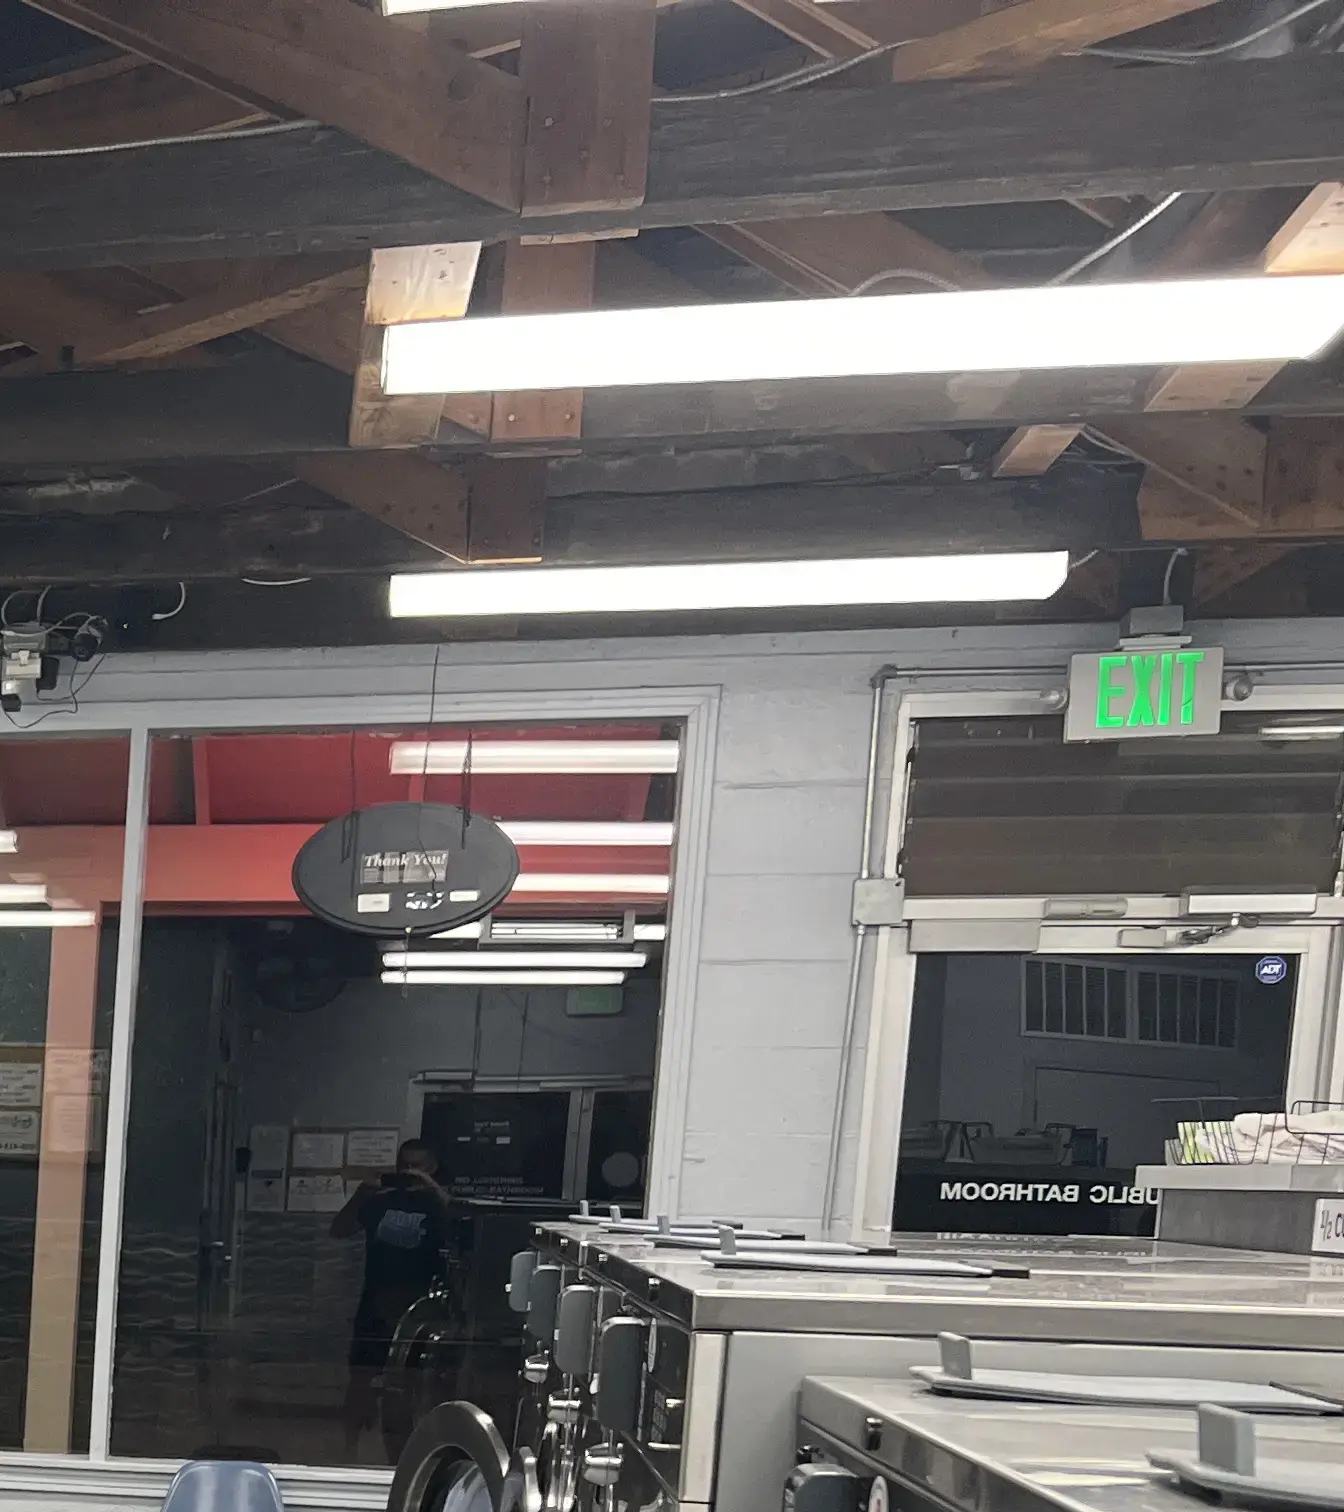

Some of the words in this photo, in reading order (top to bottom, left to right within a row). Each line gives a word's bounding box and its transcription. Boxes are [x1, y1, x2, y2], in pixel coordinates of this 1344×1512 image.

[1096, 652, 1204, 728] EXIT
[365, 854, 409, 867] Thank
[414, 853, 447, 866] You!
[1260, 964, 1282, 975] ADT
